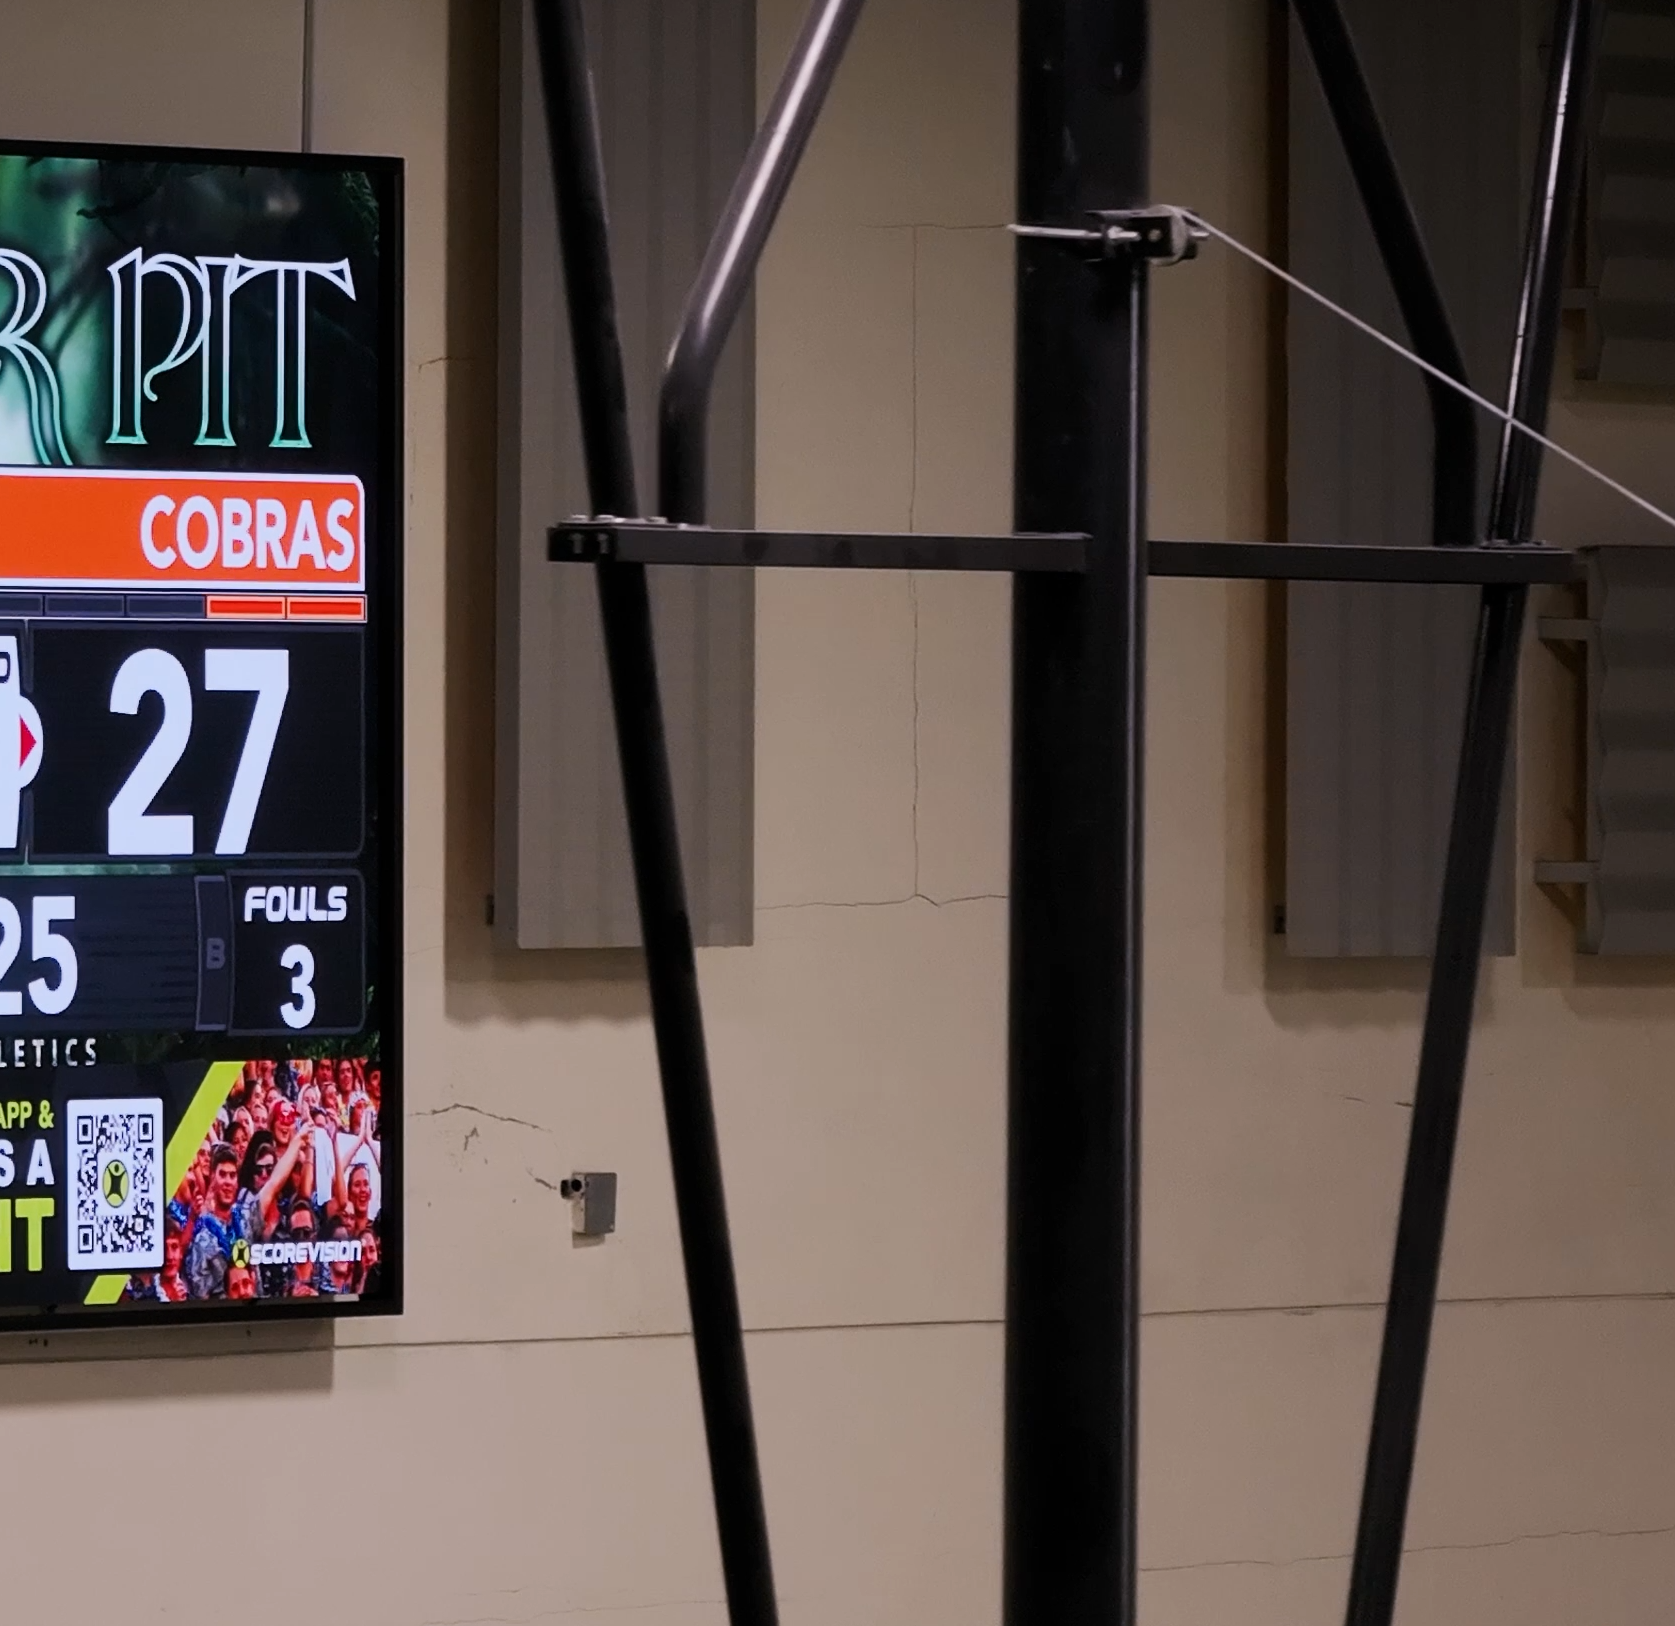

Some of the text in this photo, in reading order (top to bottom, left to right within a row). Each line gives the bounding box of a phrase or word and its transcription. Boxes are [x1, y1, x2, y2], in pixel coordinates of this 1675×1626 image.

[106, 246, 355, 449] PIT
[140, 494, 355, 572] COBRAS
[107, 647, 290, 856] 27
[243, 886, 347, 923] FOULS
[207, 938, 225, 970] B
[279, 944, 316, 1029] 3
[37, 1099, 55, 1129] &
[26, 1140, 54, 1186] A
[250, 1241, 362, 1264] SCOREVISION
